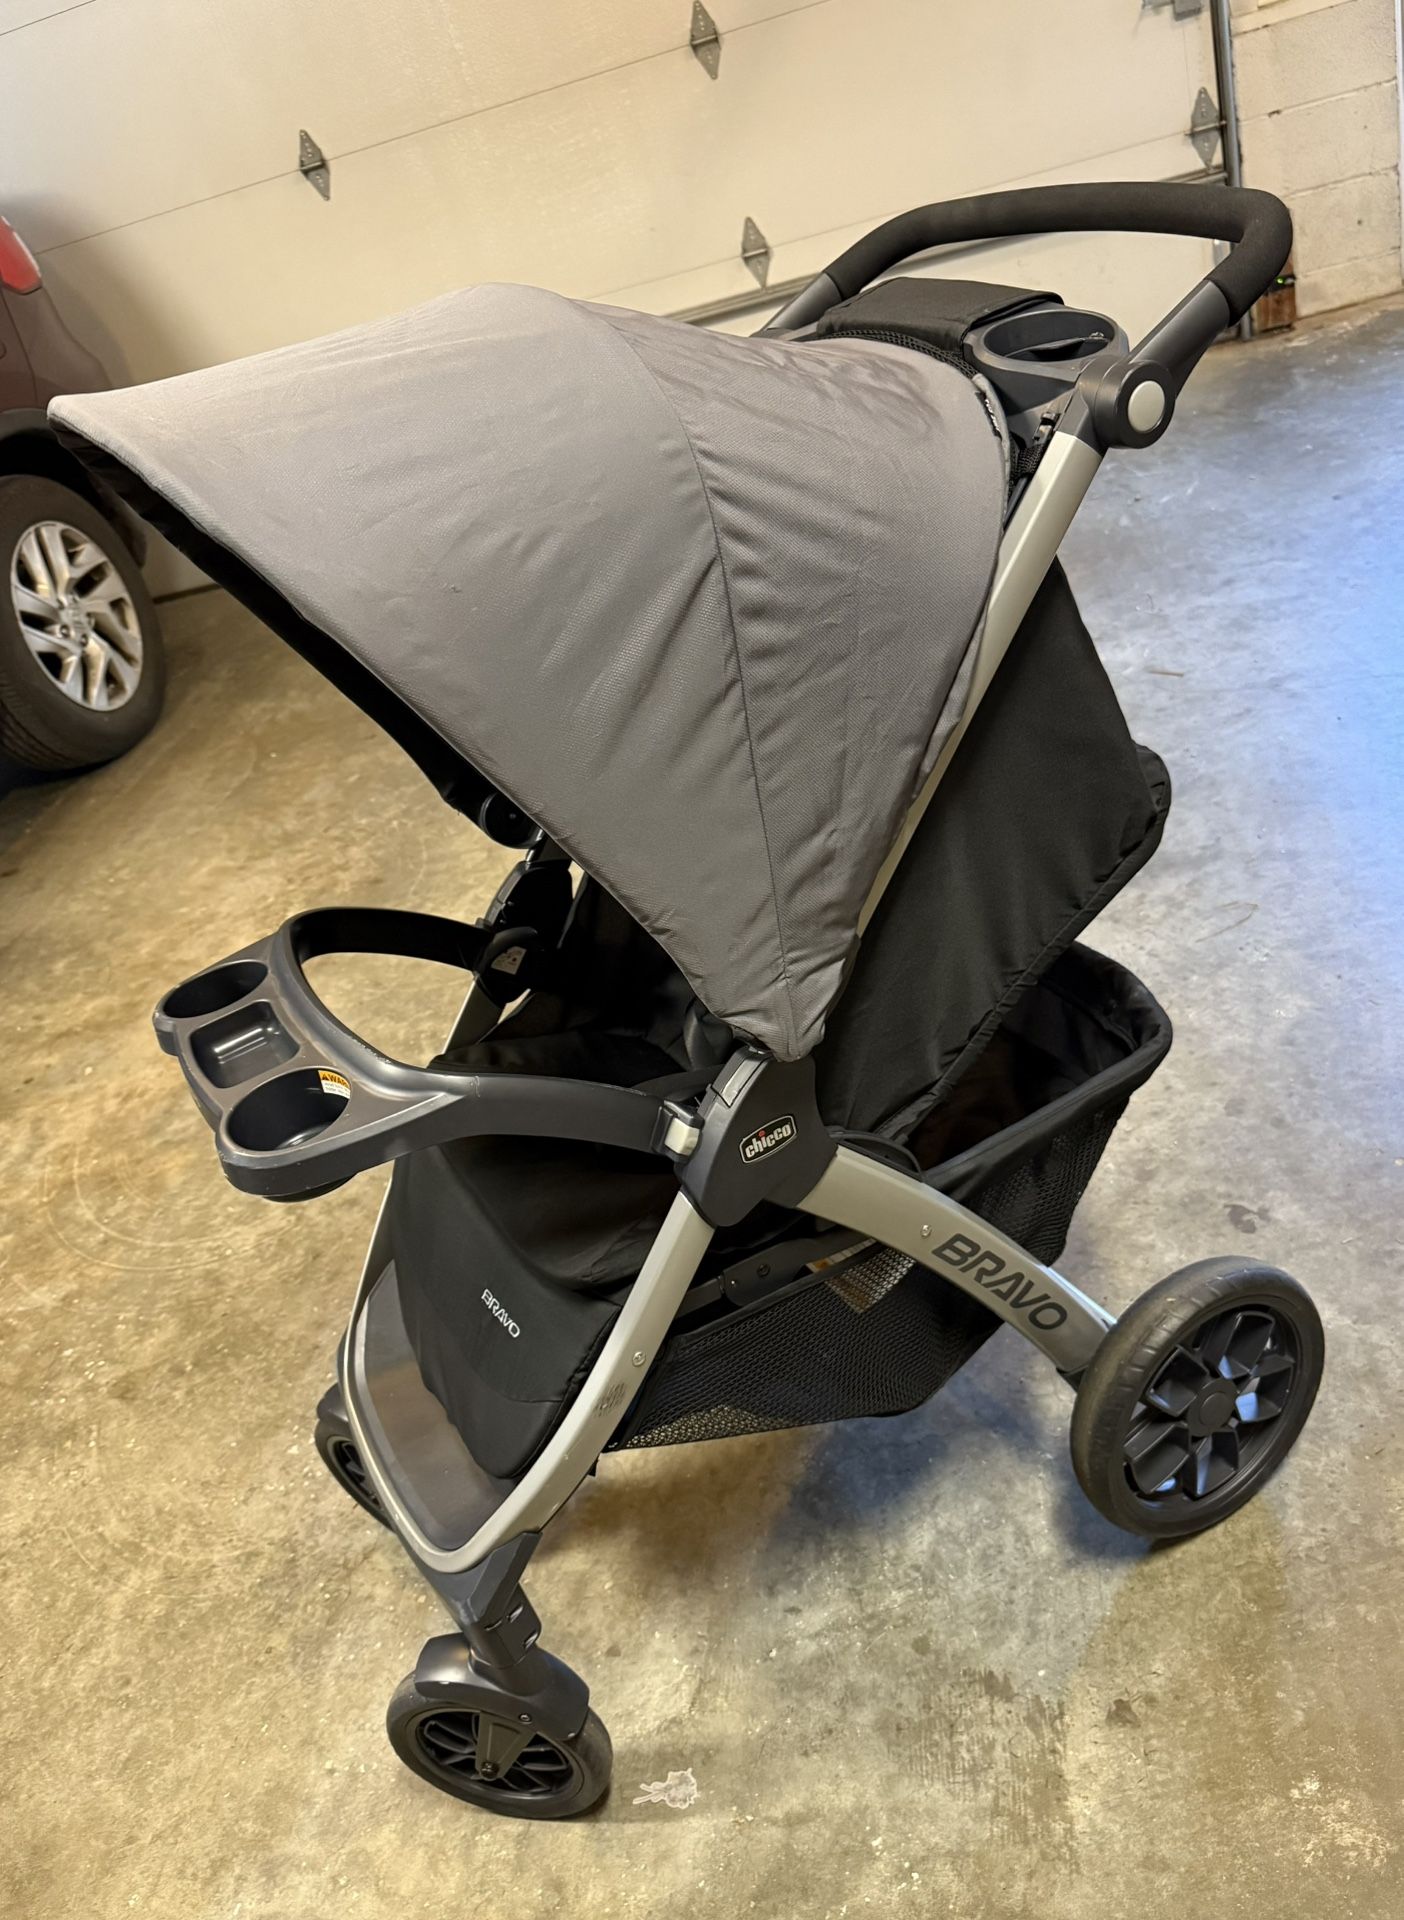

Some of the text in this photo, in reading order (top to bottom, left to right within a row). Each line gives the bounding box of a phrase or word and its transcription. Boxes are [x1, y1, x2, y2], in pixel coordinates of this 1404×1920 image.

[745, 1122, 791, 1158] chicco
[931, 1233, 1067, 1330] BRAVO
[481, 1288, 520, 1338] BRAVO
